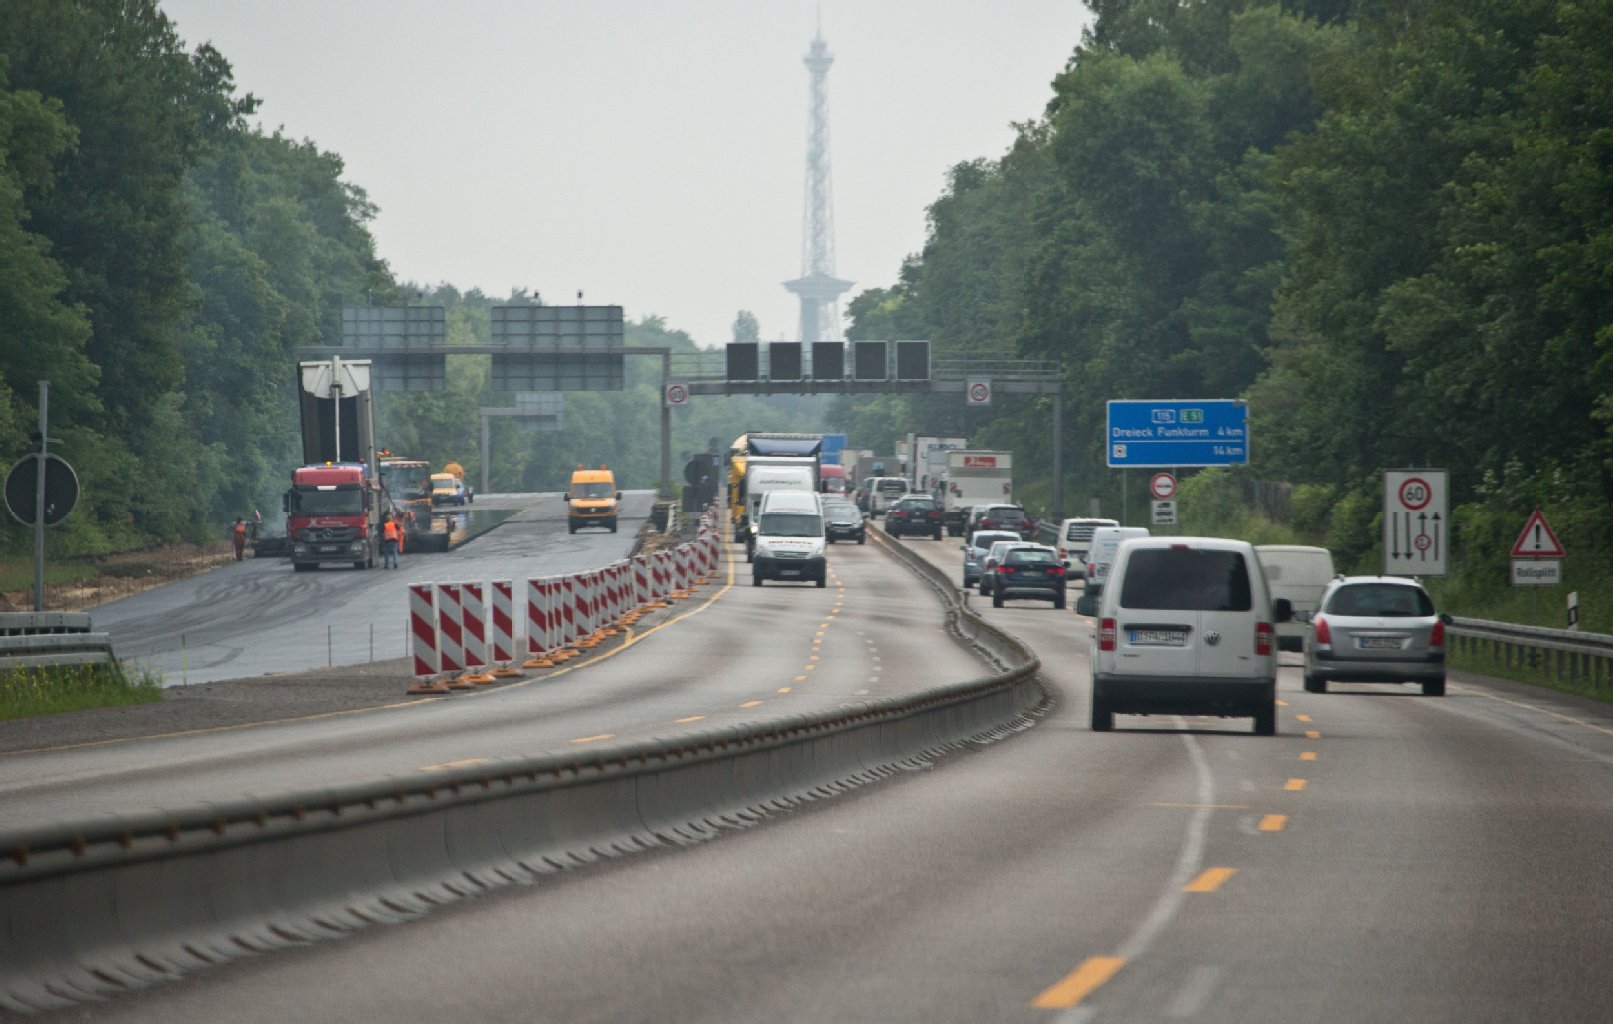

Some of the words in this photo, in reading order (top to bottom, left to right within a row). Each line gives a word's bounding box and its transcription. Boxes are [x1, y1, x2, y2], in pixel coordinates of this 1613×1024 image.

[1113, 427, 1153, 437] Dreieck
[1158, 427, 1209, 437] Funkturm
[1217, 426, 1225, 436] 4
[1226, 427, 1243, 436] km
[1213, 446, 1225, 455] 14
[1226, 446, 1243, 455] km
[1405, 486, 1424, 501] 60
